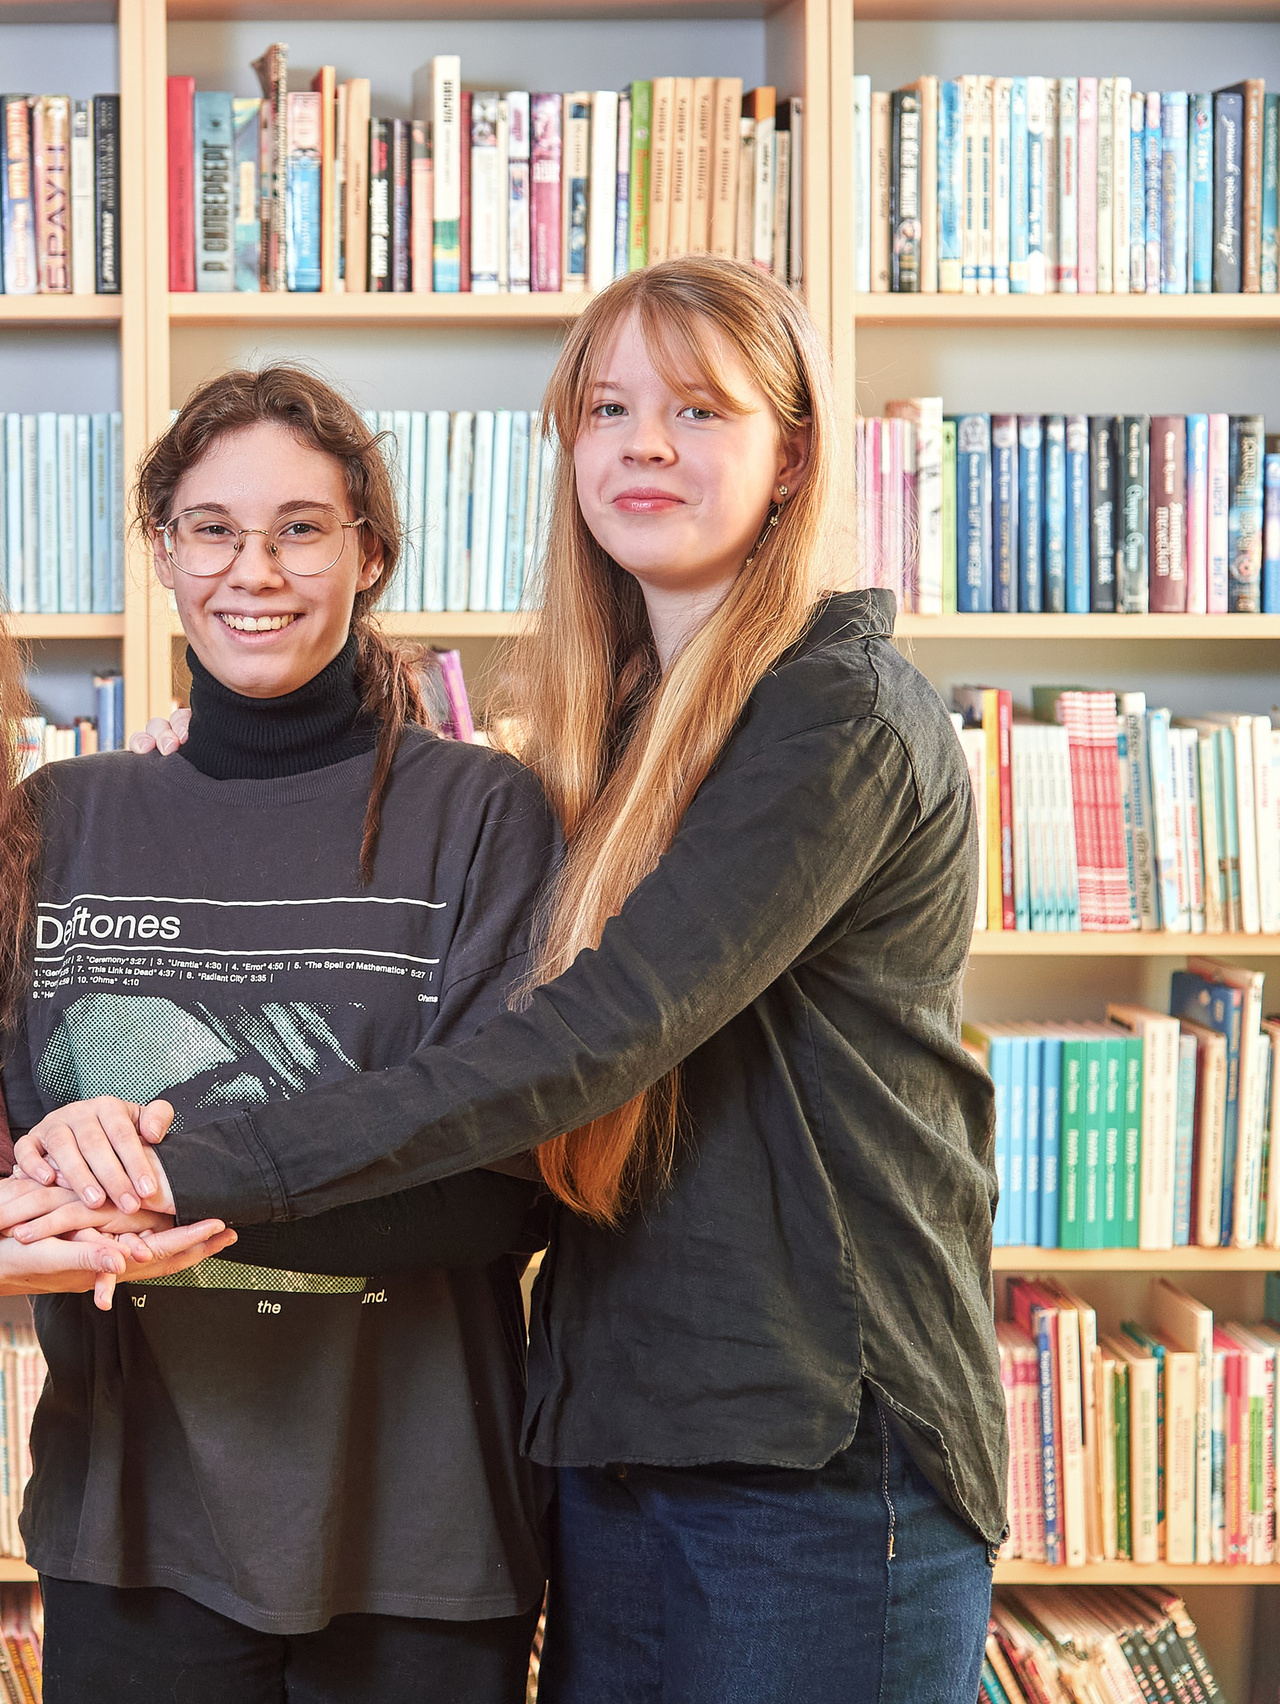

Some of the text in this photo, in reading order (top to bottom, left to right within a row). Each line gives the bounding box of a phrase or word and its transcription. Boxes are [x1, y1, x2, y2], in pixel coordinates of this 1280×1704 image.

[202, 140, 229, 252] СИЛВЕРБЕРГ
[36, 906, 181, 949] Deftones
[205, 962, 222, 970] 4:30
[324, 961, 344, 970] Spell
[345, 961, 355, 969] of
[158, 970, 175, 978] 4:37
[123, 978, 139, 986] 4:10
[417, 994, 438, 1003] Ohms
[257, 1300, 281, 1314] the
